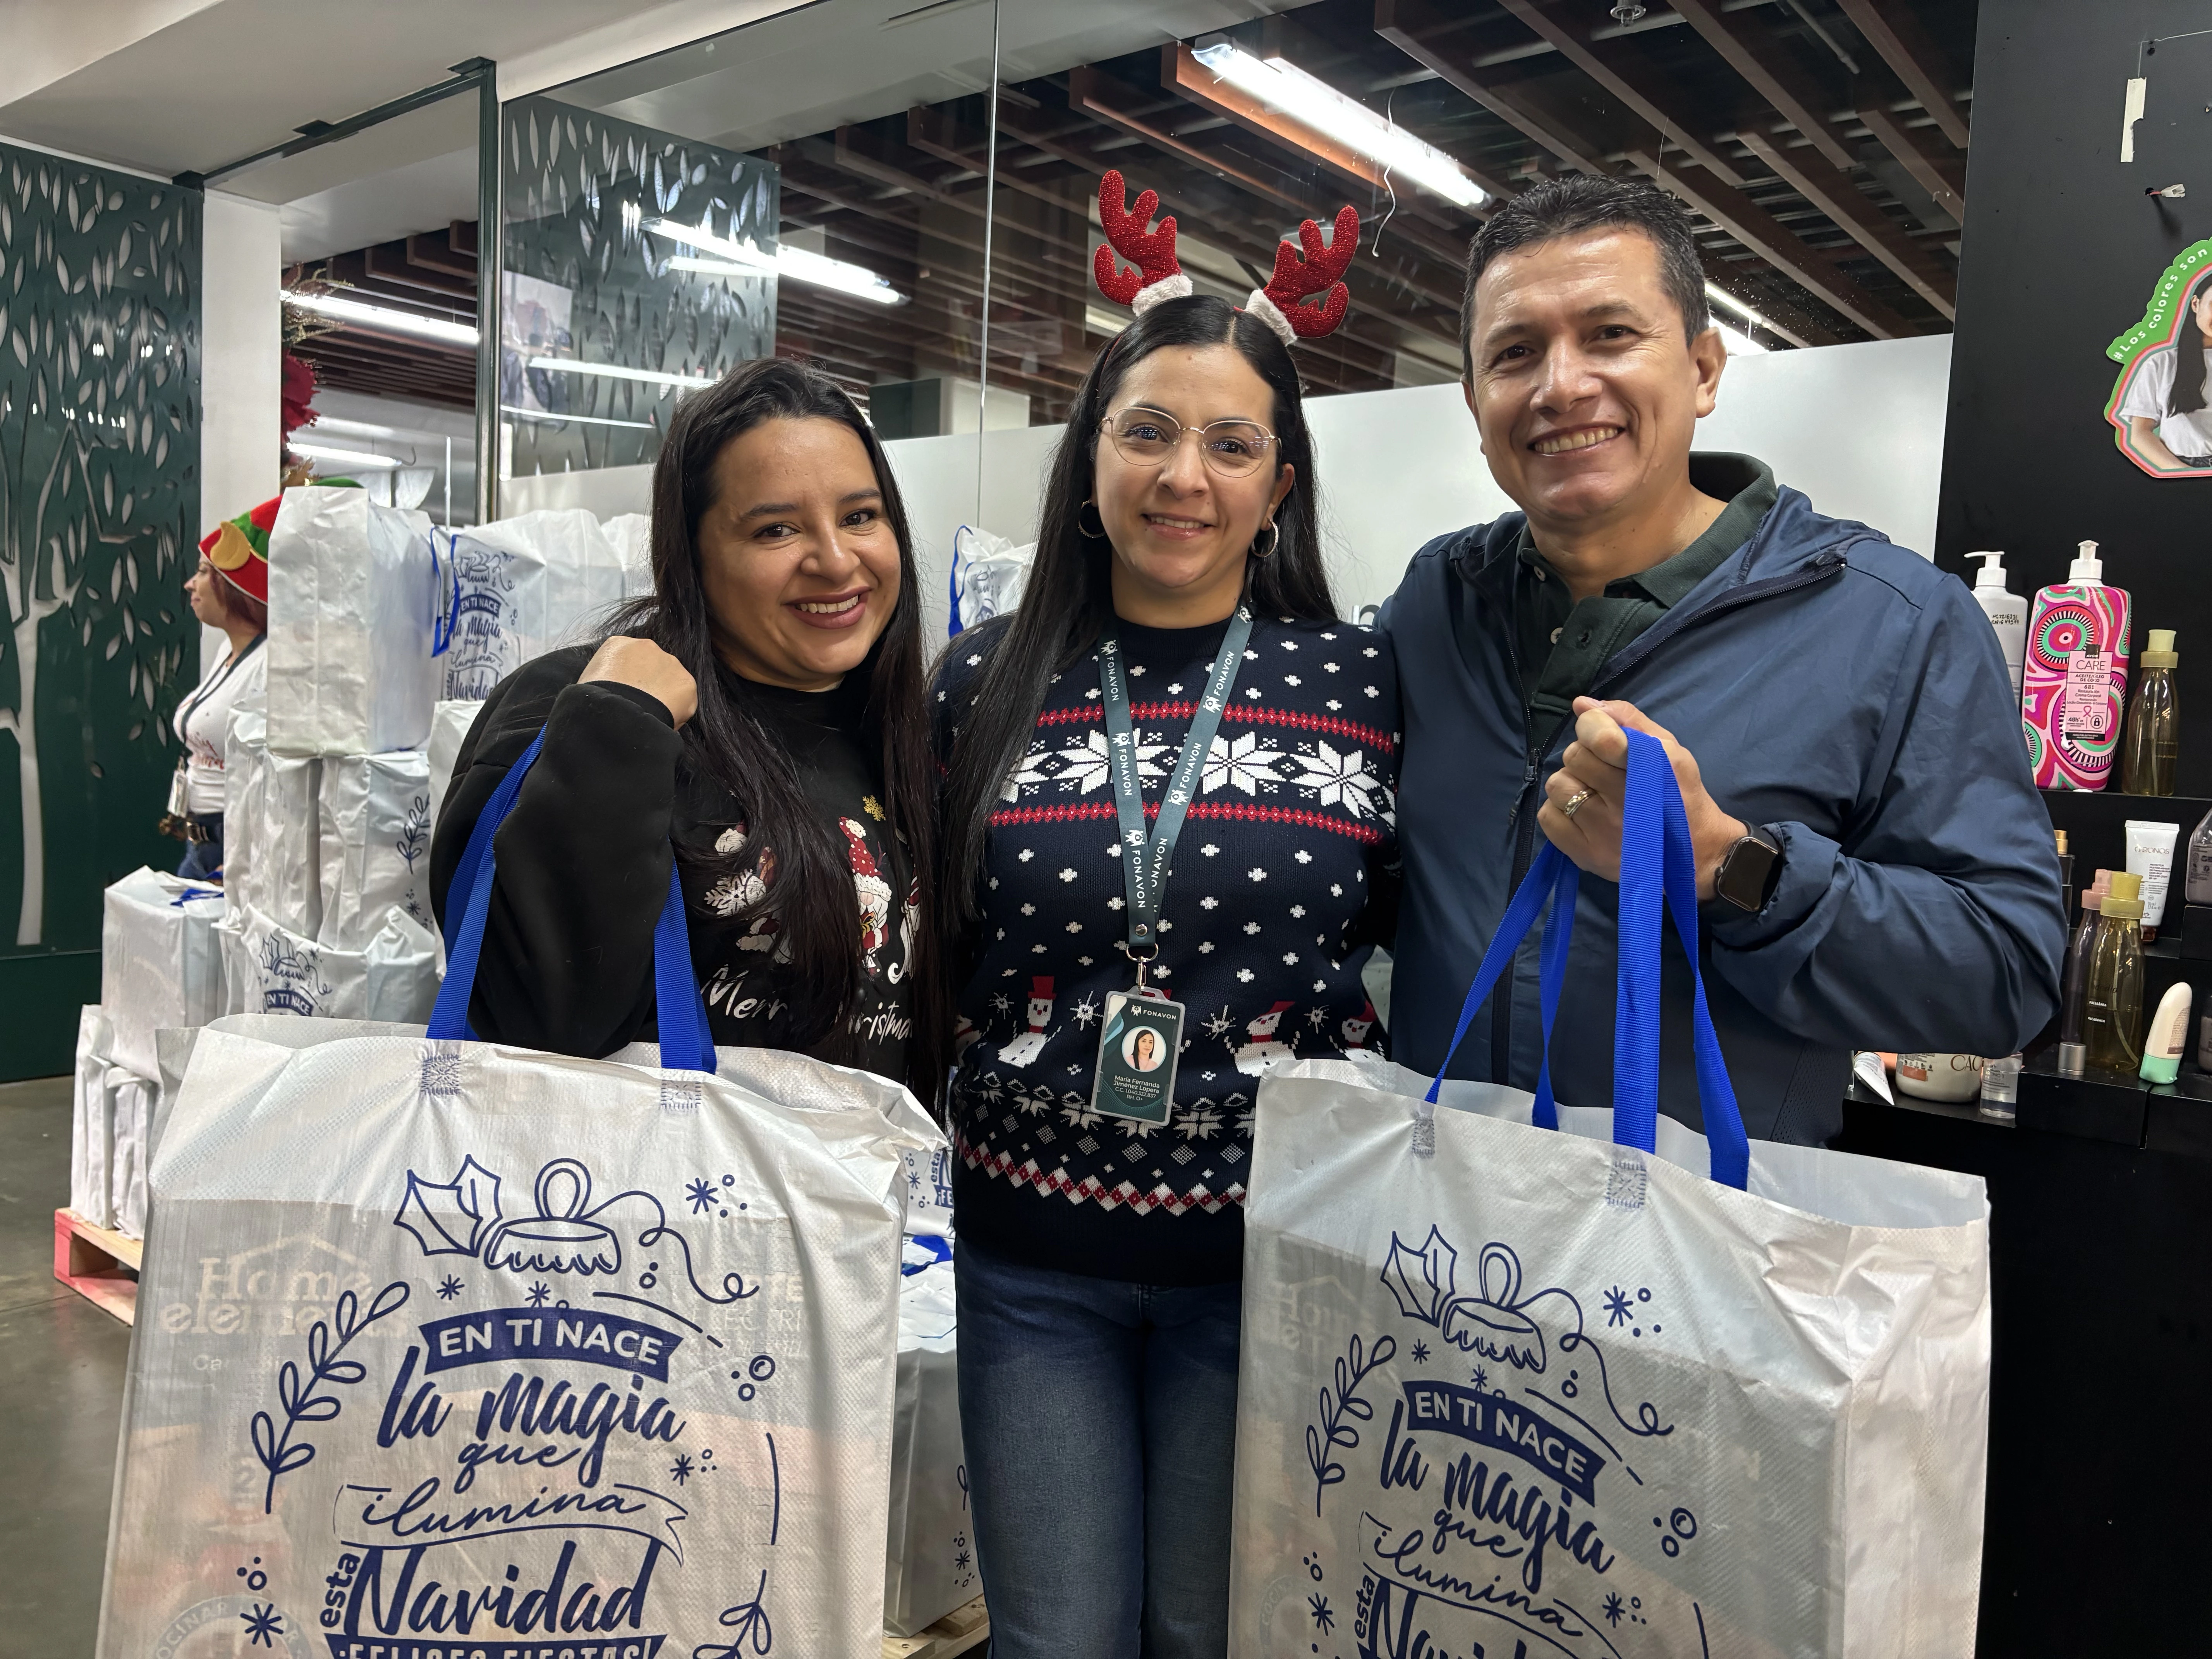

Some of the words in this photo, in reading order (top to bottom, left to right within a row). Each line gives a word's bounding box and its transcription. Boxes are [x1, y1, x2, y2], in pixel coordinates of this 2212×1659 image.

[2113, 331, 2146, 360] #Los
[2148, 275, 2178, 329] colores
[2179, 249, 2208, 270] son
[461, 599, 470, 611] EN
[470, 597, 477, 607] TI
[479, 598, 498, 613] NACE
[1107, 656, 1119, 701] FONAVON
[1214, 651, 1235, 696] FONAVON
[2076, 660, 2106, 671] CARE
[1119, 749, 1133, 796] FONAVON
[1179, 742, 1202, 788] FONAVON
[1132, 850, 1146, 908] FONAVON
[1151, 838, 1168, 895] ONAVON
[267, 993, 276, 1005] EN
[279, 993, 289, 1004] TI
[291, 995, 309, 1015] NACE
[701, 964, 788, 1020] Merr
[1143, 1009, 1176, 1020] FONAVON
[1113, 1080, 1138, 1090] Jiménez
[1139, 1085, 1159, 1094] Lopera
[1132, 1079, 1160, 1088] Fernanda
[439, 1322, 491, 1357] EN
[506, 1319, 542, 1346] TI
[555, 1320, 663, 1365] NACE
[377, 1346, 453, 1448] la
[1380, 1399, 1429, 1491] la
[1415, 1391, 1450, 1421] EN
[1456, 1397, 1482, 1432] TI
[1496, 1408, 1587, 1483] NACE
[453, 1439, 582, 1494] que
[362, 1477, 646, 1537] ilumina
[1433, 1509, 1523, 1554] que
[319, 1553, 361, 1628] esta
[343, 1538, 663, 1637] Navidad
[1354, 1575, 1375, 1639] esta
[1374, 1529, 1583, 1636] ilumina
